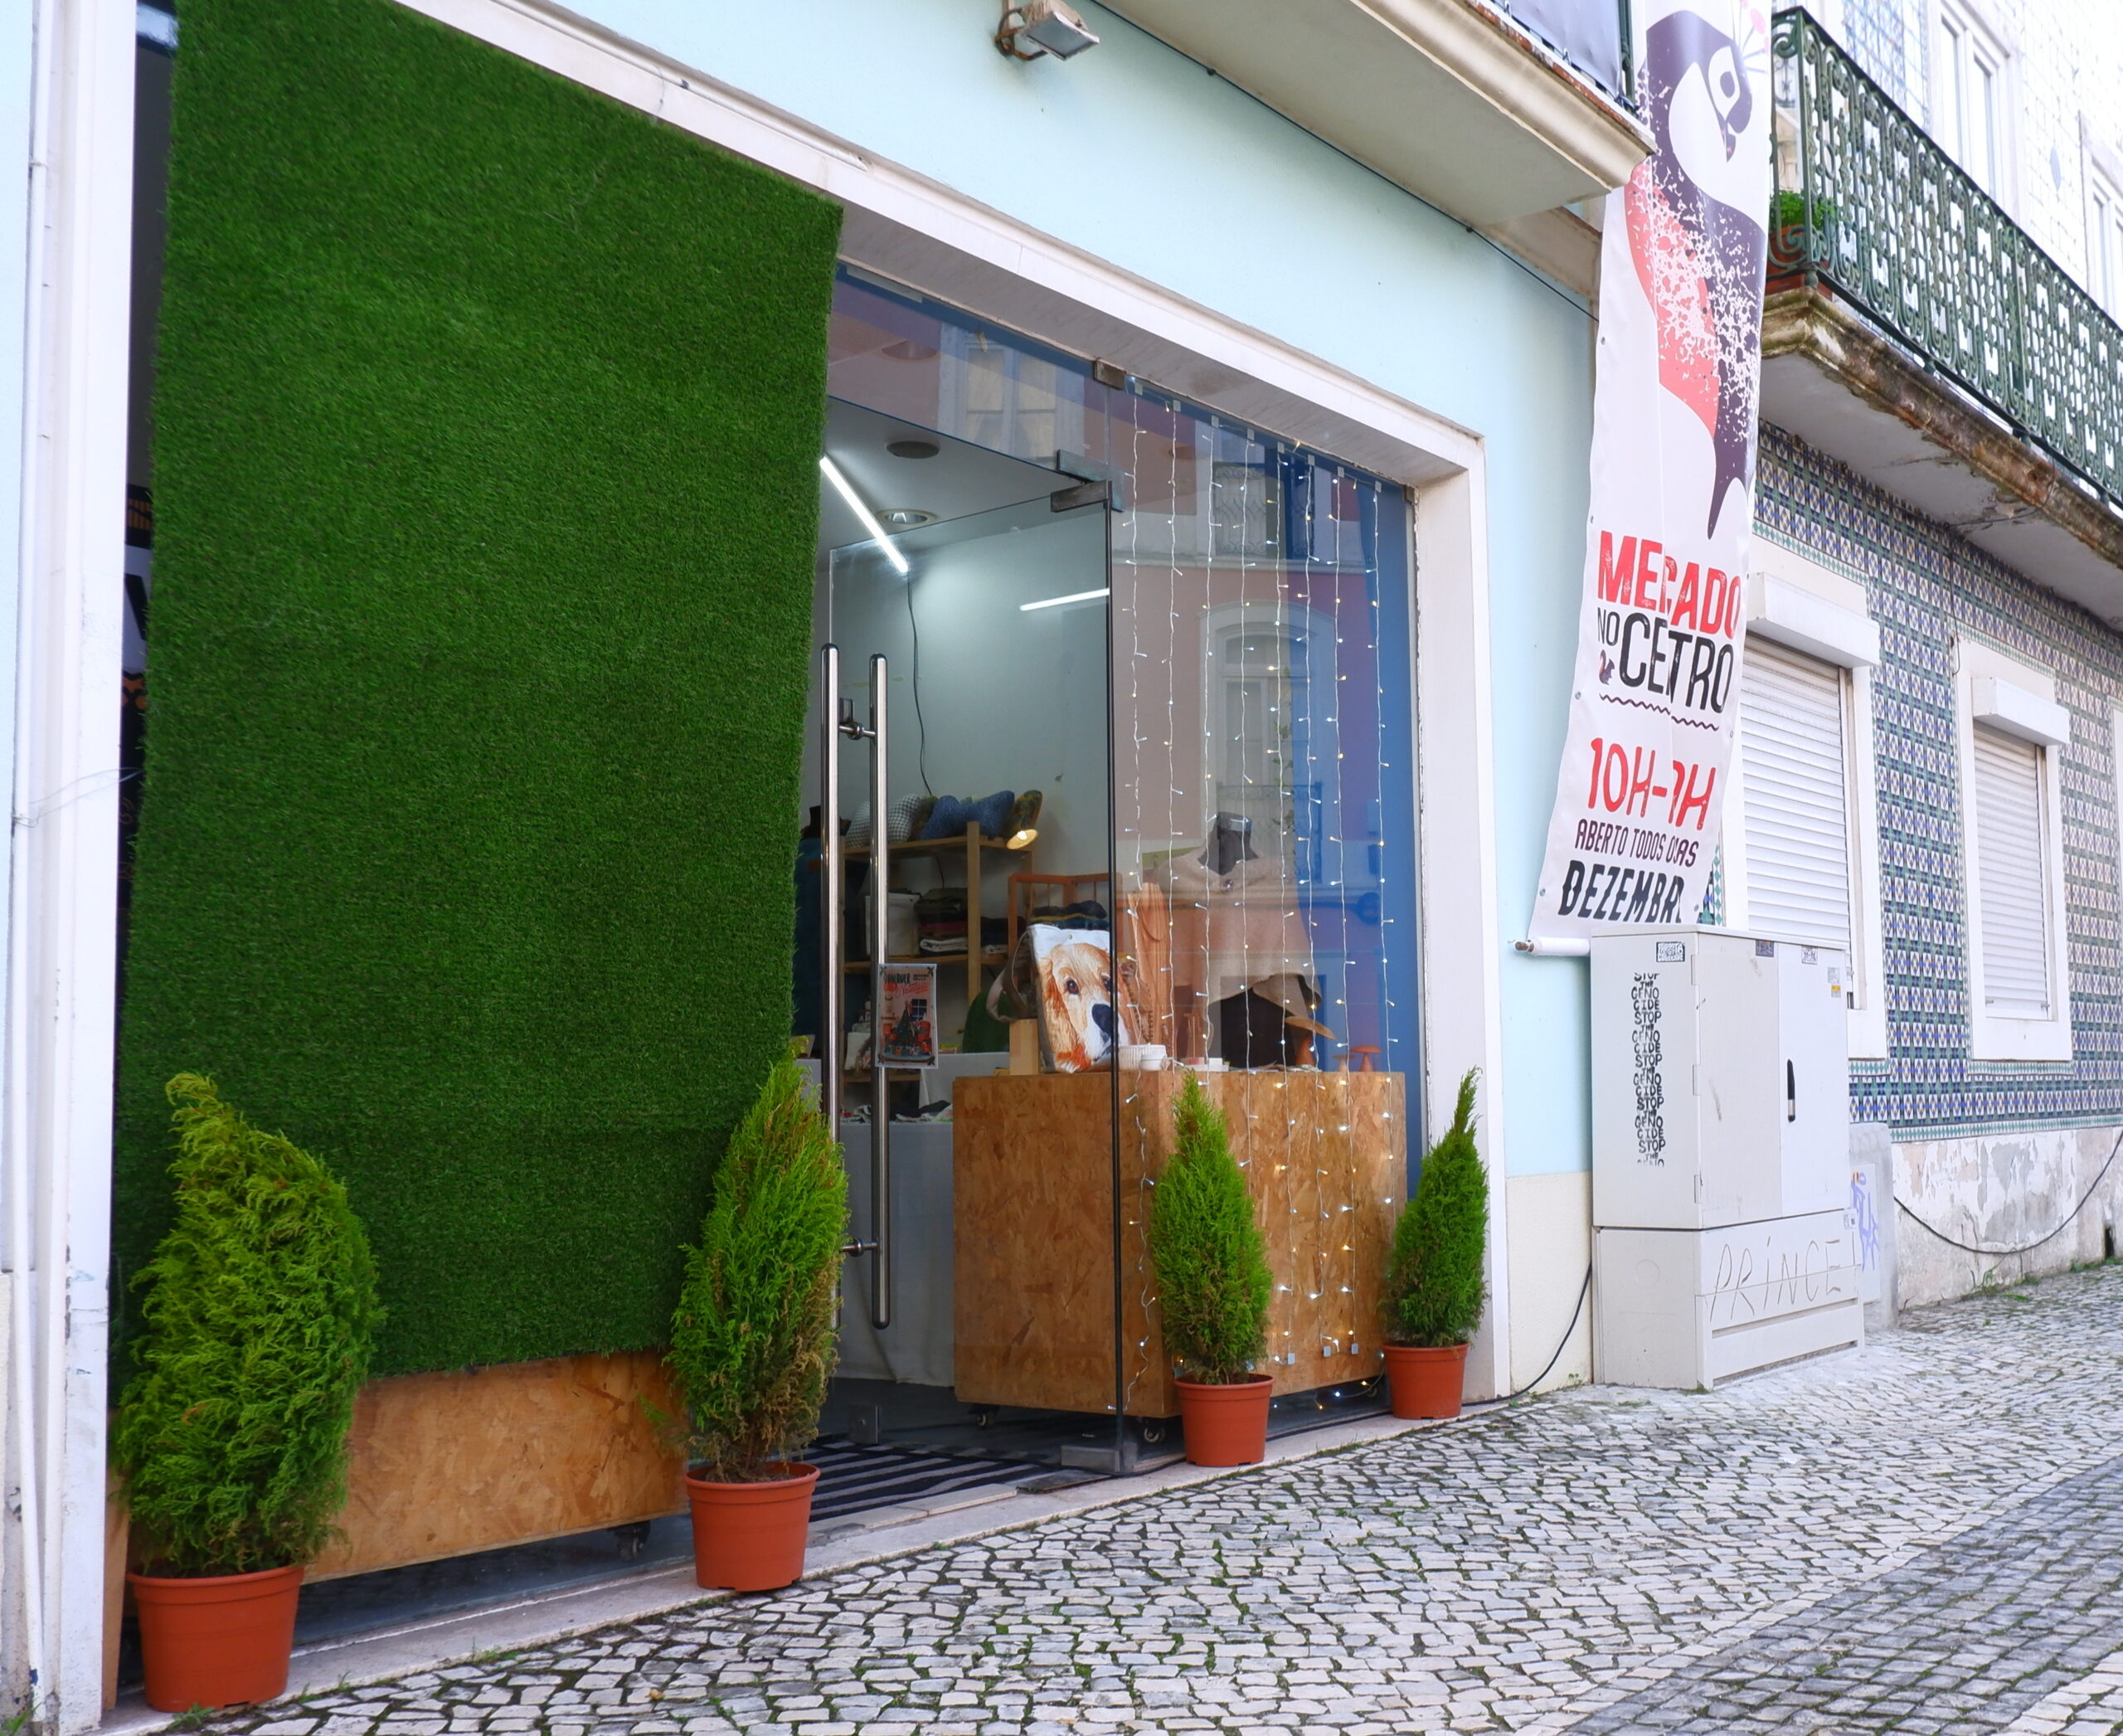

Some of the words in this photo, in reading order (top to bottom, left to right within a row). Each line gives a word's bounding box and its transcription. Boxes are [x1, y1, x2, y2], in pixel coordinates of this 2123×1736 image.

[1597, 607, 1620, 646] NO
[1575, 819, 1629, 856] ABERTO
[1630, 829, 1666, 862] TODOS
[1557, 860, 1684, 923] DEZEMBR
[1633, 999, 1659, 1011] CIDE
[1635, 1010, 1662, 1024] STOP
[1634, 1043, 1660, 1054] CIDE
[1635, 1053, 1663, 1067] STOP
[1635, 1085, 1662, 1097] CIDE
[1636, 1097, 1664, 1111] STOP
[1637, 1128, 1664, 1139] CIDE
[1639, 1139, 1666, 1153] STOP
